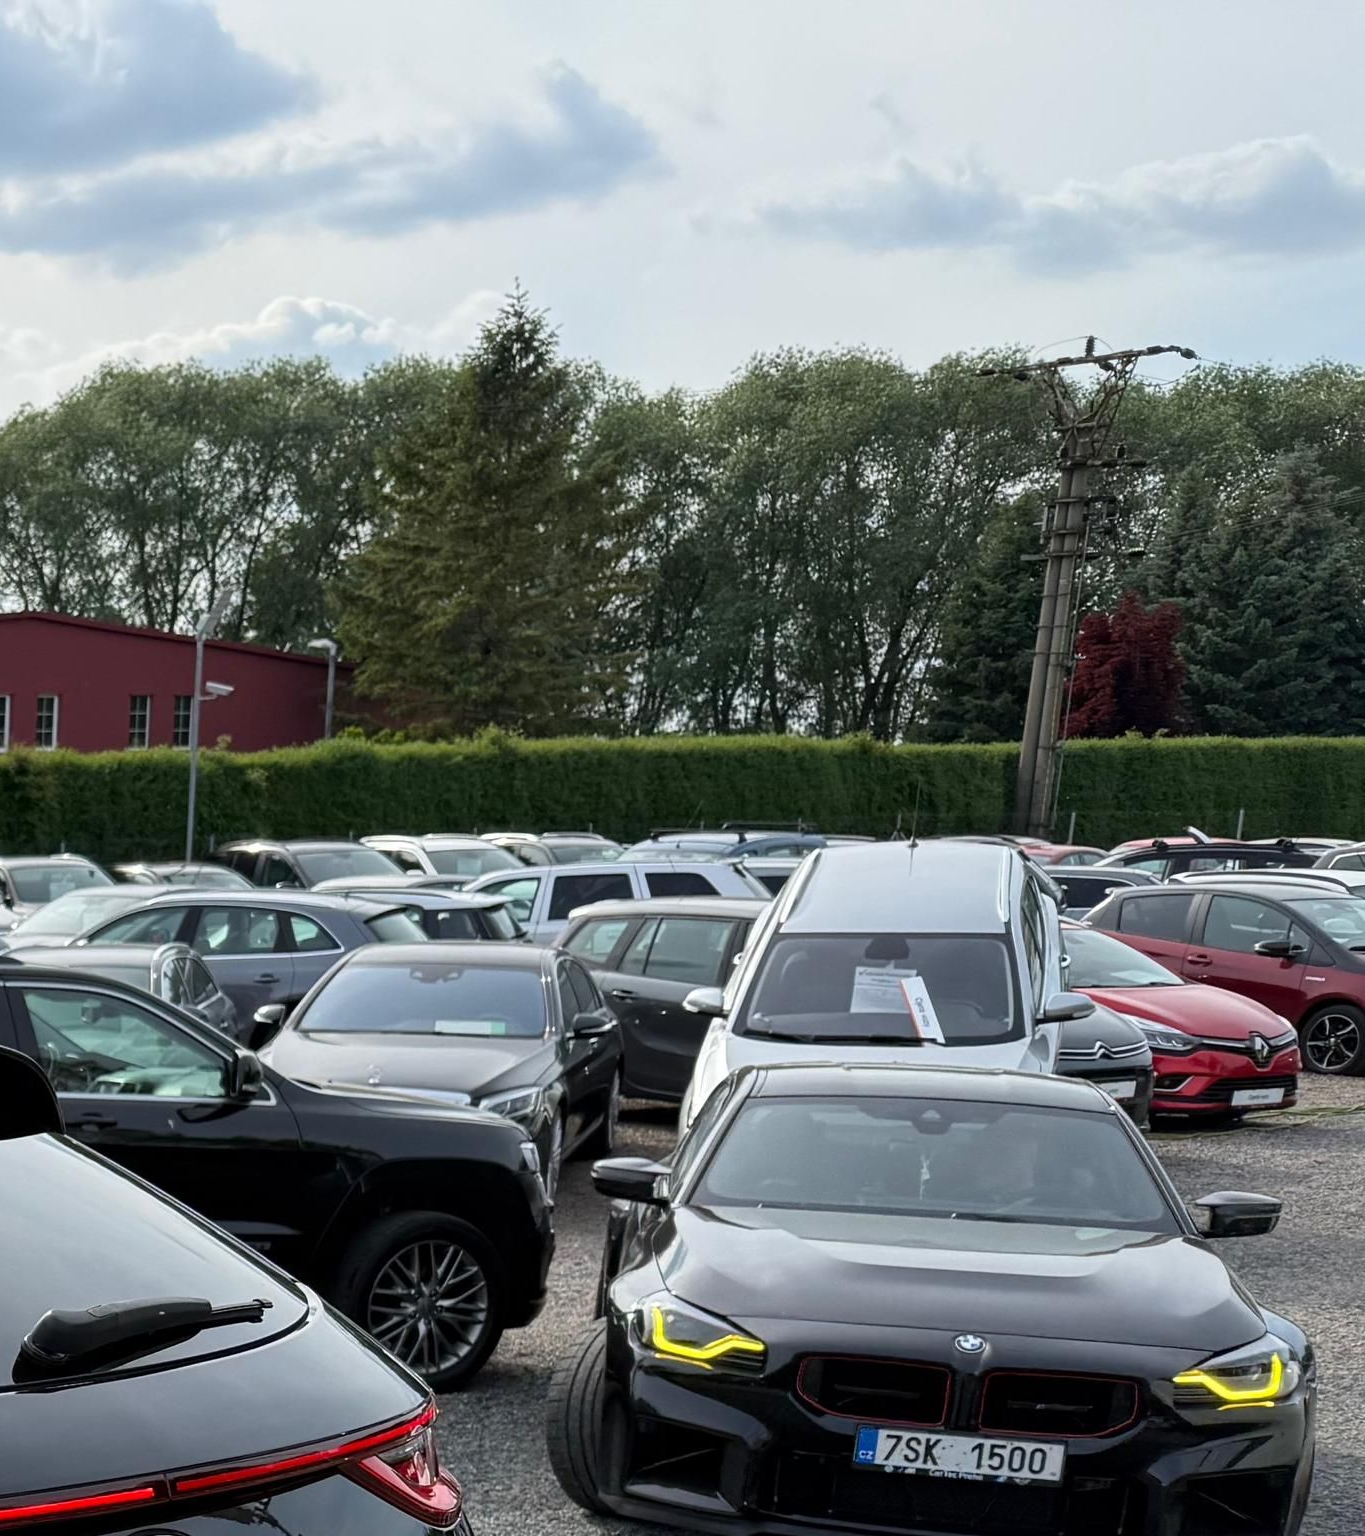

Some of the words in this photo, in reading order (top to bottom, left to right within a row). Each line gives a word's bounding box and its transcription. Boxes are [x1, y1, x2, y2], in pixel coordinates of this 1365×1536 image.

[858, 1450, 874, 1460] CZ
[883, 1434, 943, 1466] 7SK
[970, 1442, 1048, 1475] 1500
